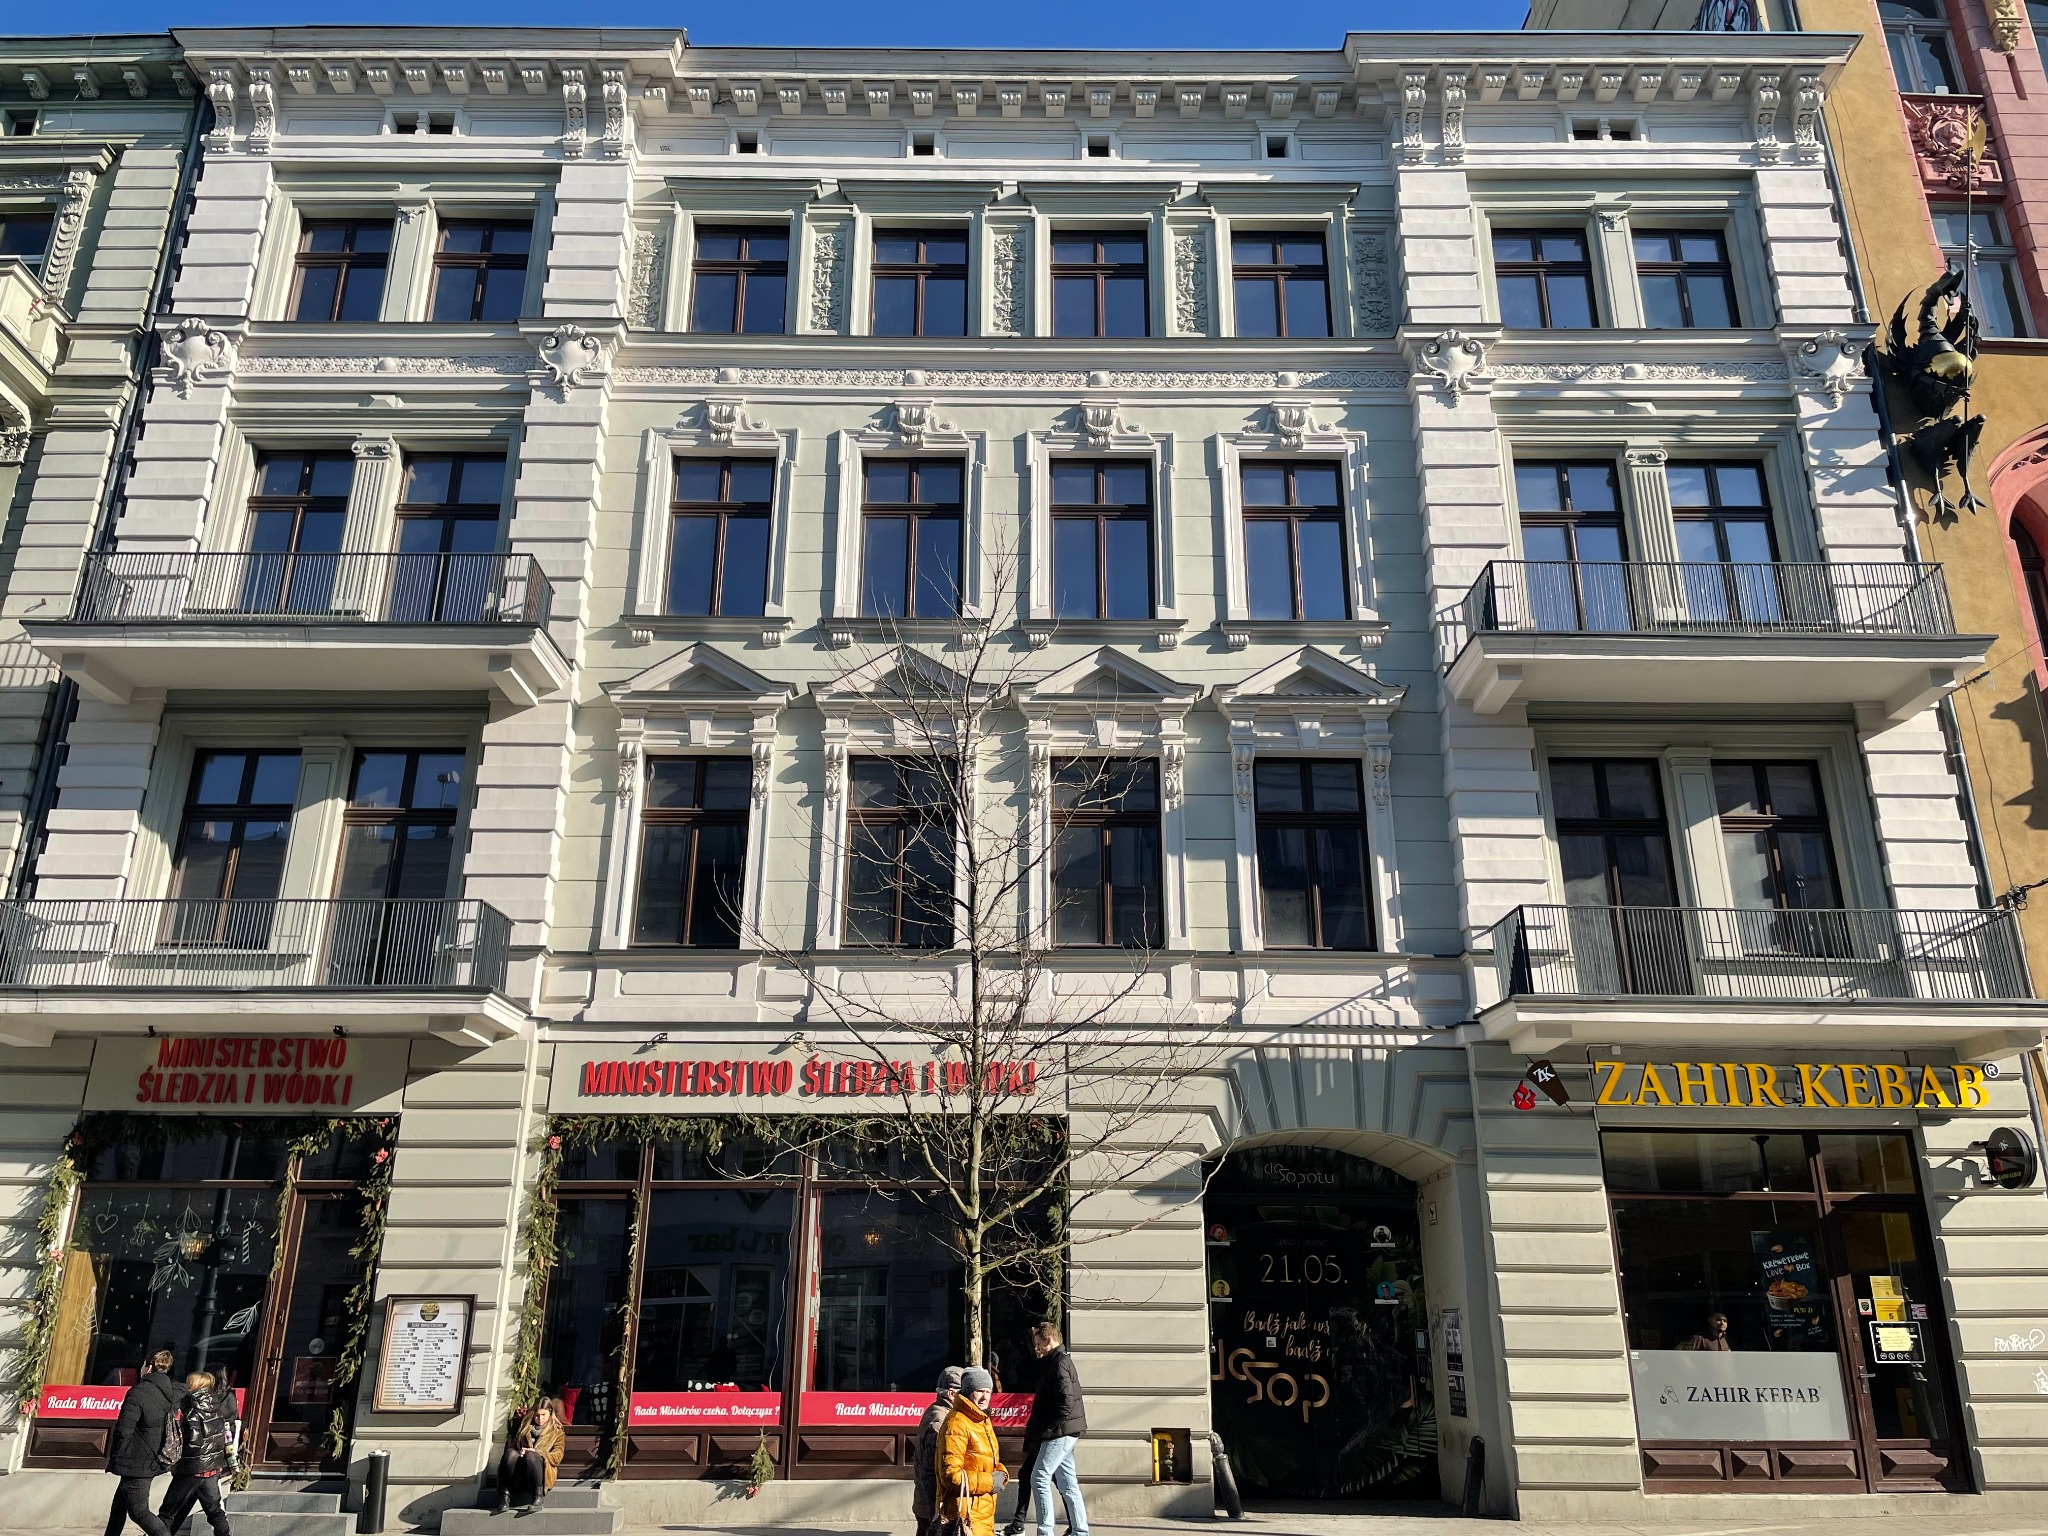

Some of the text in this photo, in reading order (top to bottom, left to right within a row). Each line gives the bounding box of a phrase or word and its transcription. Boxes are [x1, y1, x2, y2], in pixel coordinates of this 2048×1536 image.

[157, 1038, 347, 1068] MINISTERSTWO
[136, 1065, 353, 1106] ŚLEDZIA I WÓDKI
[584, 1052, 1036, 1096] MINISTERSTWO ŚLEDZIA I WDKI
[1594, 1060, 1786, 1107] ZAHIR
[1259, 1253, 1348, 1284] 21.05.
[1280, 1311, 1307, 1339] jak
[47, 1396, 77, 1410] Rada
[835, 1402, 866, 1416] Rada
[868, 1403, 924, 1416] Ministrów
[1686, 1386, 1821, 1404] ZAHIR KEBAB
[634, 1405, 780, 1419] Rada Ministrów czeka. Dołączysz ?
